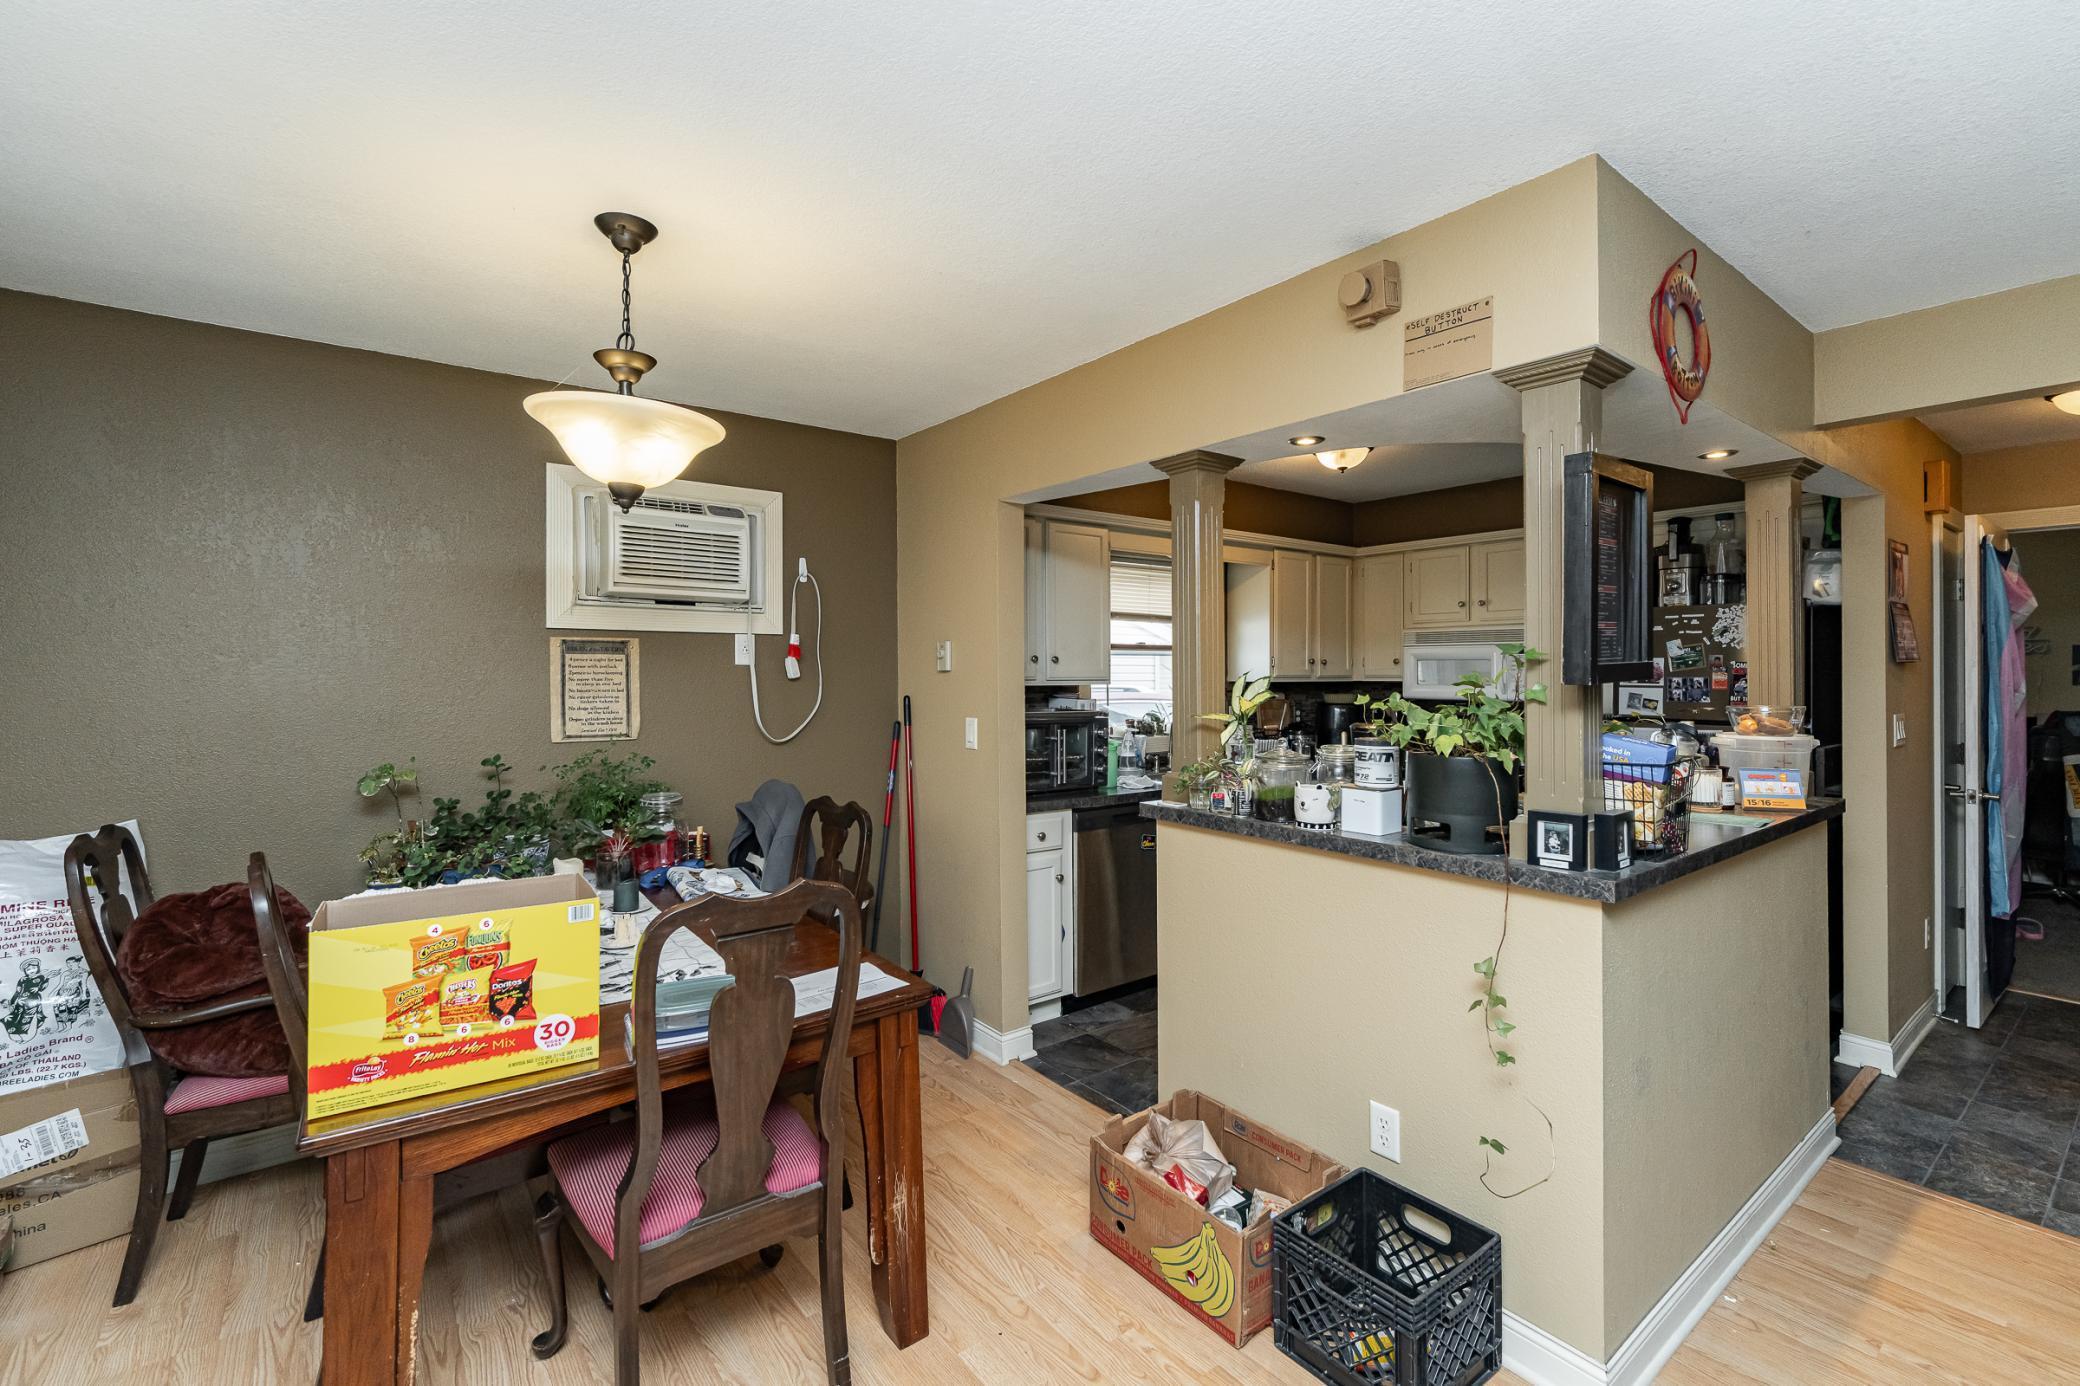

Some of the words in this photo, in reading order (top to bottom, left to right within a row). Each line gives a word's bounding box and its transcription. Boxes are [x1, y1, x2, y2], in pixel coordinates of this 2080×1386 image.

[1411, 318, 1430, 329] SELF
[1434, 302, 1479, 322] DESTRUCT
[1424, 316, 1463, 335] BUTTON
[1624, 747, 1631, 757] in
[4, 923, 43, 934] SUPER
[418, 938, 457, 960] Cheetos
[492, 979, 523, 990] Doritos
[396, 984, 425, 1006] Cheetos
[408, 1035, 415, 1043] 8
[461, 1026, 468, 1034] 6
[540, 1020, 570, 1040] 30
[6, 1043, 46, 1060] Ladies
[49, 1033, 84, 1047] Brand
[460, 1042, 488, 1055] Hot
[492, 1037, 516, 1050] Mix
[15, 1061, 29, 1070] OF
[32, 1053, 82, 1066] THAILAND
[1132, 1245, 1154, 1271] PACK
